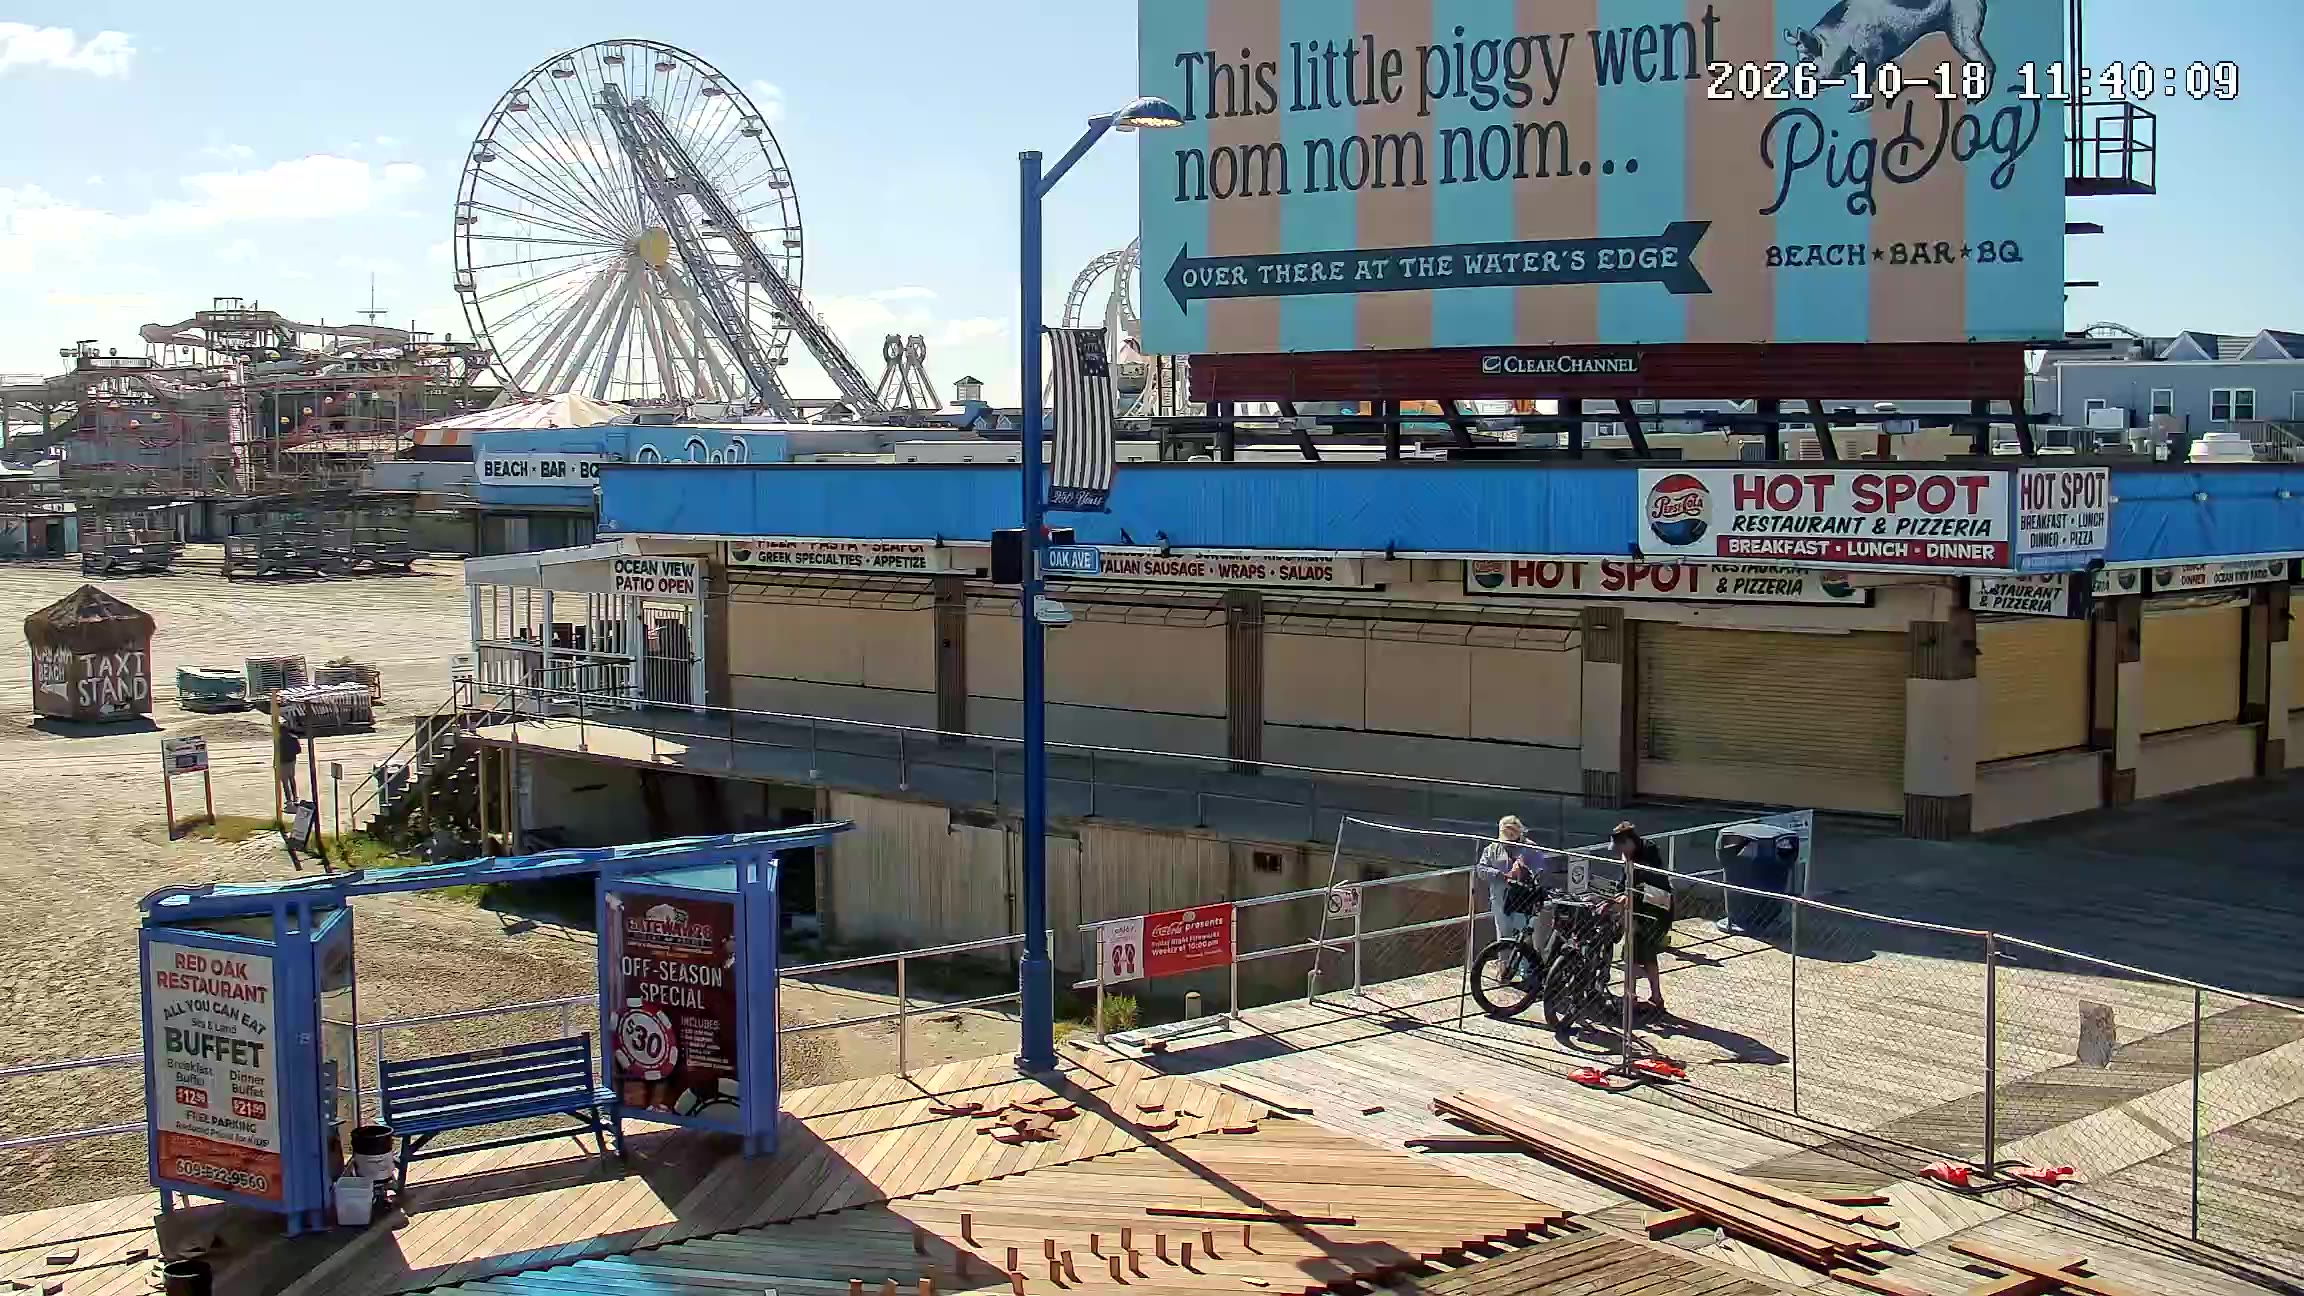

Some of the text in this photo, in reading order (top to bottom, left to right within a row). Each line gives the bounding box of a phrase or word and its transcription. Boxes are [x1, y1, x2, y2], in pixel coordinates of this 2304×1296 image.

[1174, 5, 1721, 121] This little piggy went
[1174, 120, 1639, 202] nom nom nom...
[1766, 240, 2024, 268] BEACH BAR BQ
[1182, 246, 1679, 290] OVER THERE AT THE WATER'S EDGE
[484, 460, 527, 477] BEACH
[541, 461, 566, 478] BAR
[1733, 473, 1990, 515] HOT SPOT
[2021, 472, 2105, 510] HOT SPOT
[1731, 514, 1992, 537] RESTAURANT & PIZZERIA
[2020, 512, 2104, 530] BREAKFAST LUNCH
[1729, 538, 1995, 561] BREAKFAST LUNCH DINNER
[2030, 531, 2093, 548] DINNER PIZZA
[615, 560, 694, 577] OCEAN VIEW
[759, 551, 791, 564] GREEK
[795, 552, 863, 566] SPECIALTIES
[1050, 551, 1069, 567] OAK
[1071, 552, 1092, 568] AVE
[1100, 560, 1333, 581] TALIAN SAUSAGE WRAPS SALADS
[616, 576, 694, 594] PATIO OPEN
[1511, 559, 1707, 592] HOT SPOT
[1716, 577, 1803, 595] & PIZZERIA
[1993, 597, 2052, 612] PIZZERIA
[38, 663, 64, 681] BEACH
[80, 652, 145, 677] TAXI
[78, 677, 148, 706] STAND
[175, 952, 248, 980] RED OAK
[622, 956, 722, 987] OFF-SEASON
[157, 971, 267, 1003] RESTAURANT
[640, 982, 706, 1010] SPECIAL
[164, 1000, 266, 1035] ALL YOU CAN EAT
[164, 1027, 264, 1068] BUFFET
[626, 1018, 662, 1058] $30
[230, 1070, 264, 1085] Dinner
[232, 1083, 264, 1097] Buffet
[212, 1116, 256, 1133] PARKING
